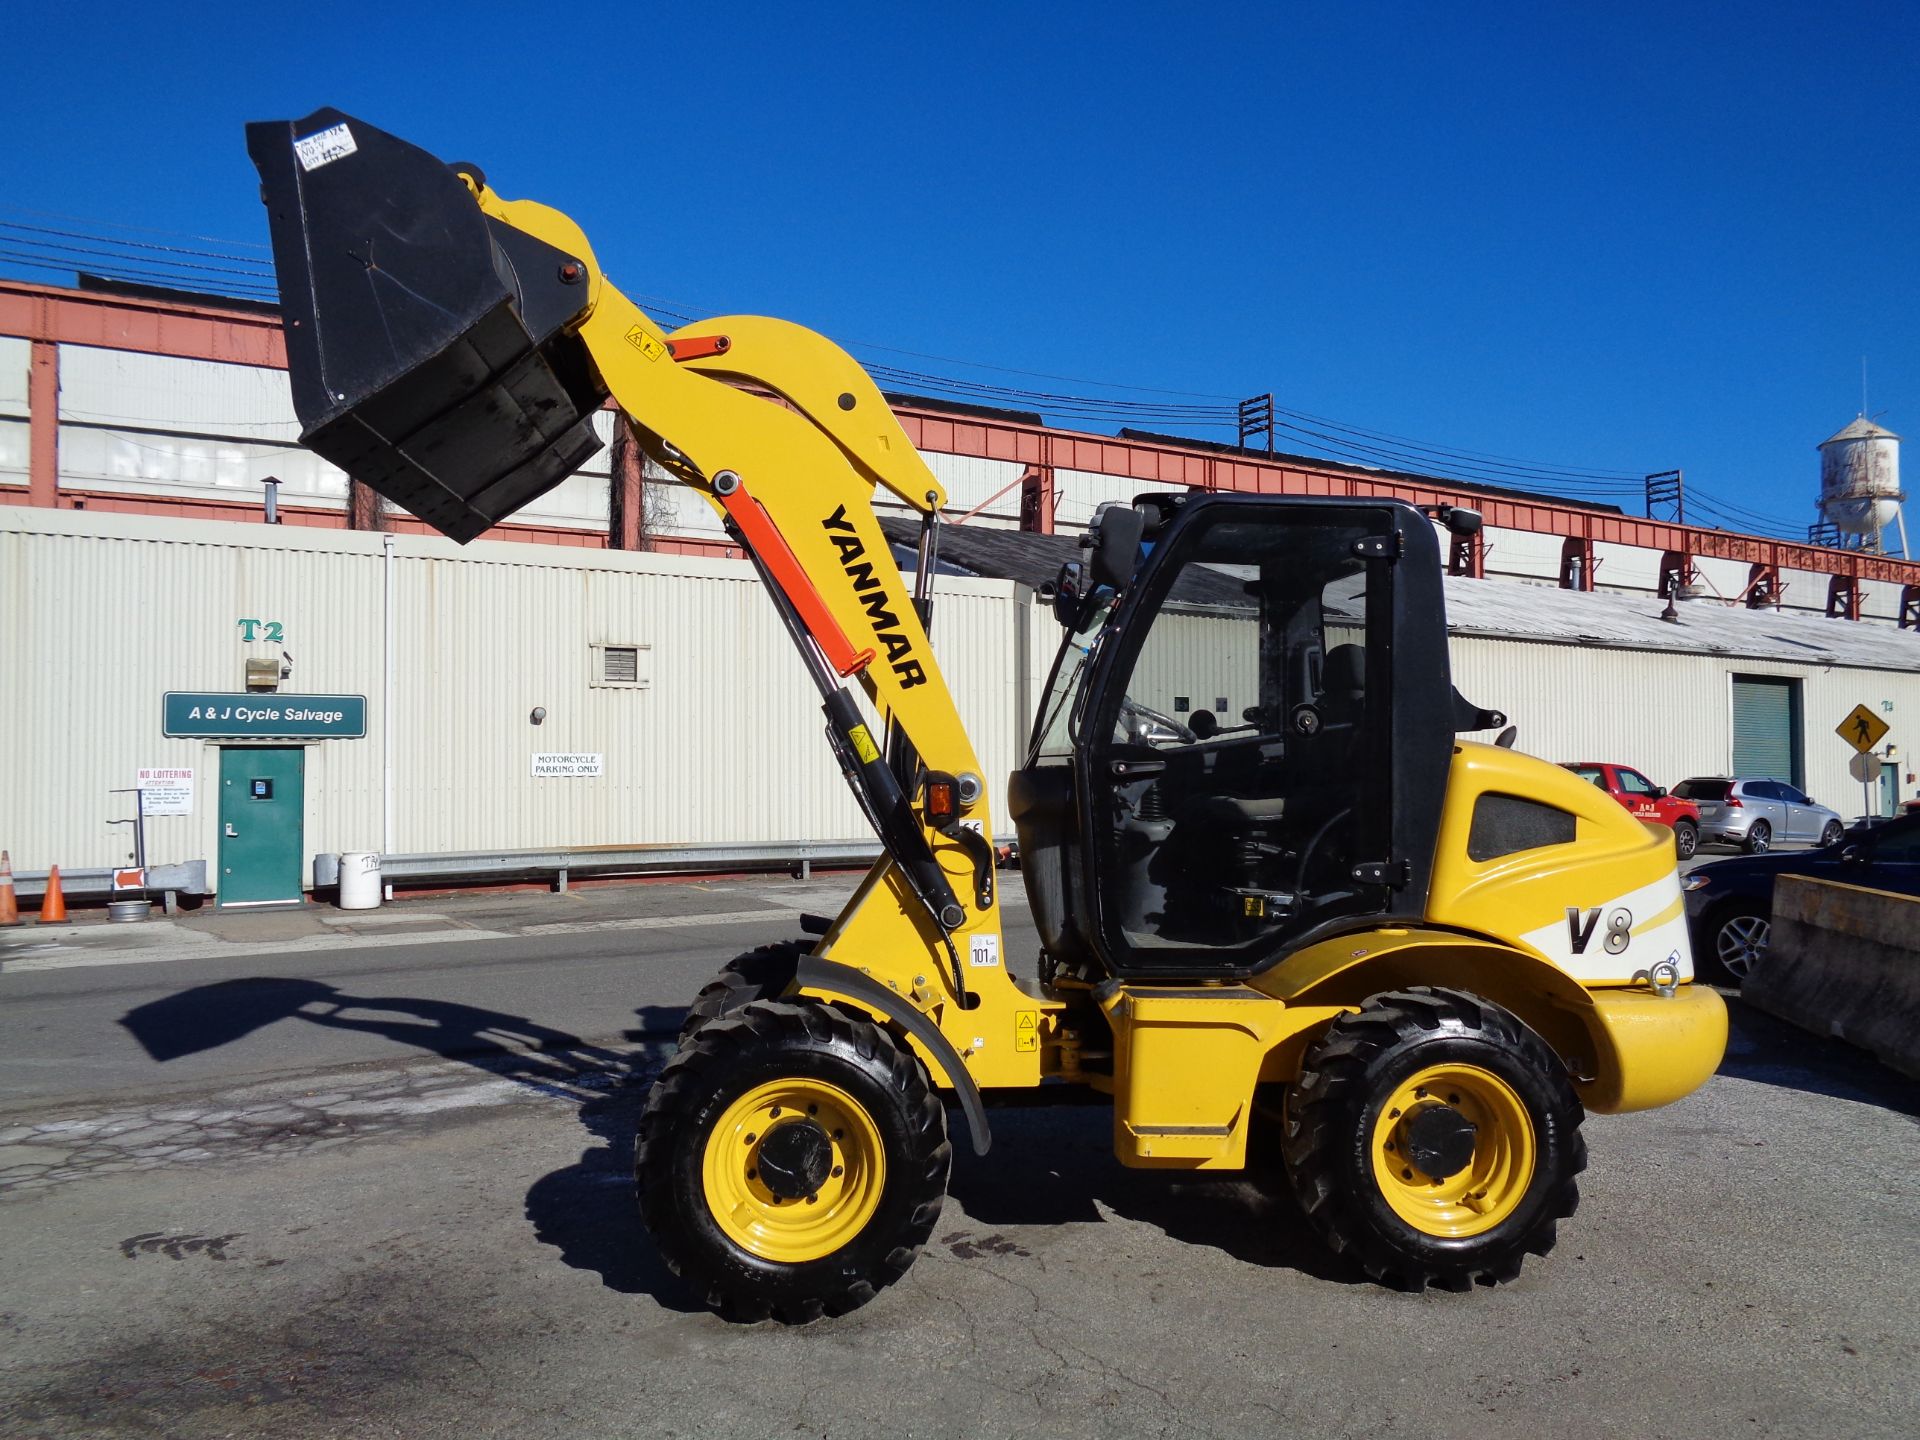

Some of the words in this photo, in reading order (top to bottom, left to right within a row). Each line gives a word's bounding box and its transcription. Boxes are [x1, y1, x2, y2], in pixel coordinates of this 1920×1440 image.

[822, 503, 927, 690] YANMAR
[237, 618, 284, 642] T2
[189, 707, 201, 719] A
[205, 707, 216, 719] &
[221, 707, 231, 719] J
[235, 707, 280, 723] Cycle
[284, 708, 343, 724] Salvage
[538, 755, 596, 764] MOTORCYCLE
[140, 770, 150, 778] NO
[153, 770, 192, 778] LOITERING
[535, 765, 574, 773] PARKING
[577, 765, 599, 773] ONLY
[1566, 907, 1632, 955] V8
[972, 948, 988, 963] 101
